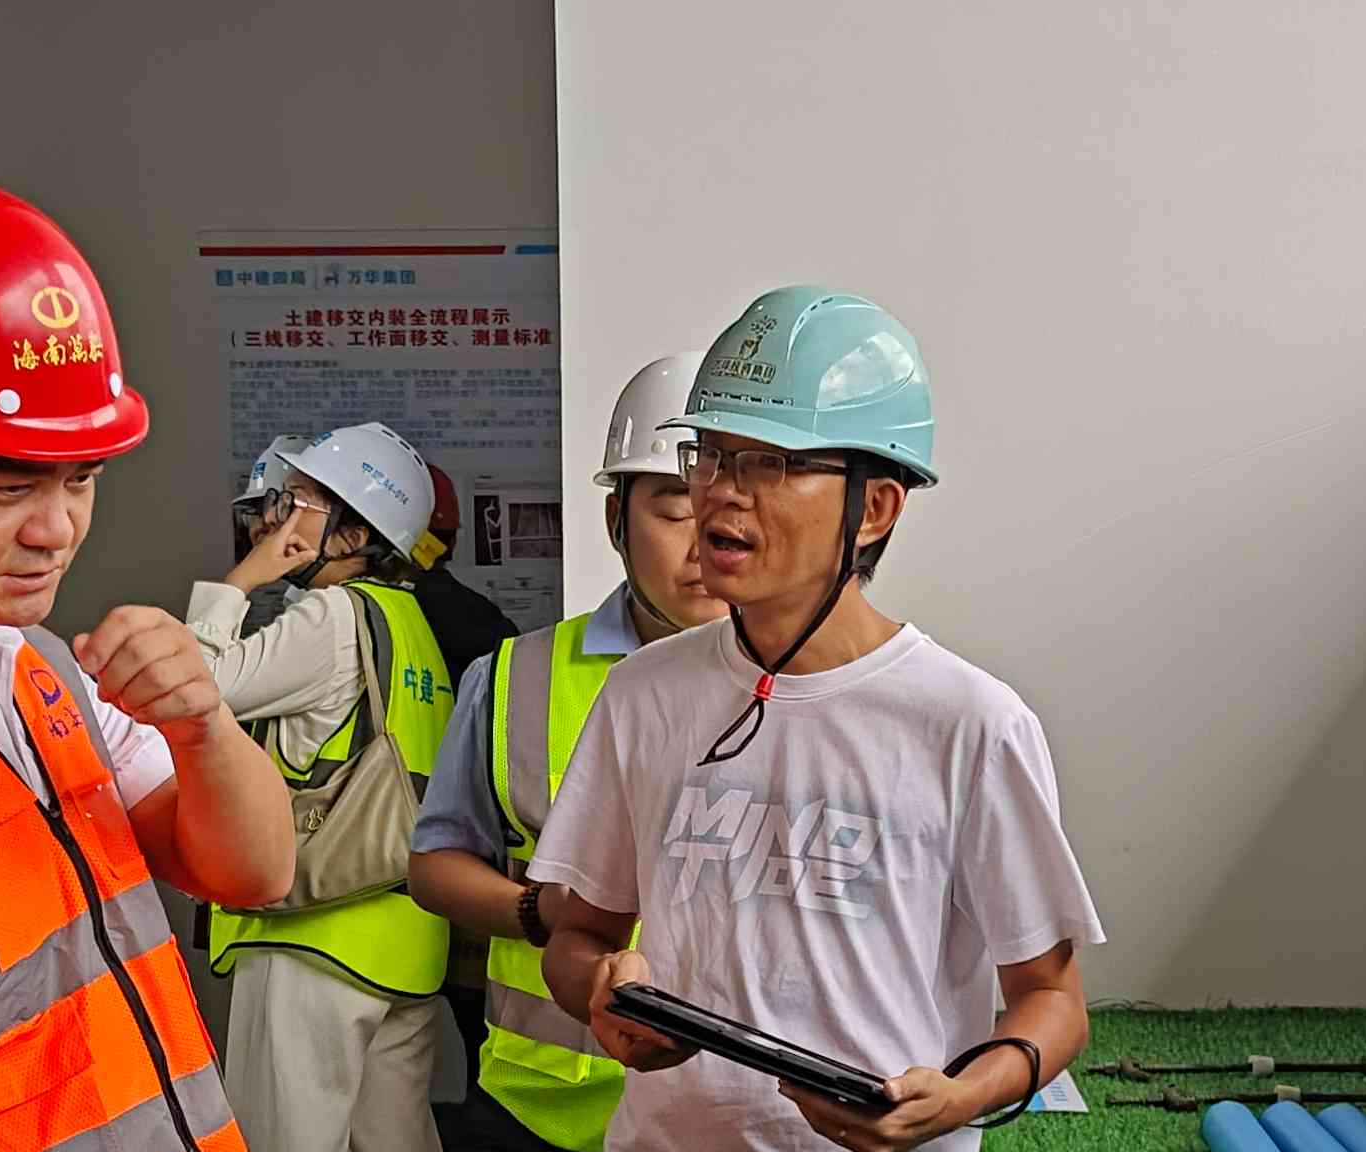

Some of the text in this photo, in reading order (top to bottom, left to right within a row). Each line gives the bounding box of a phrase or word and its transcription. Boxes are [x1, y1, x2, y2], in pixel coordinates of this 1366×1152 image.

[285, 307, 511, 327] 土建移交内装全流程展示
